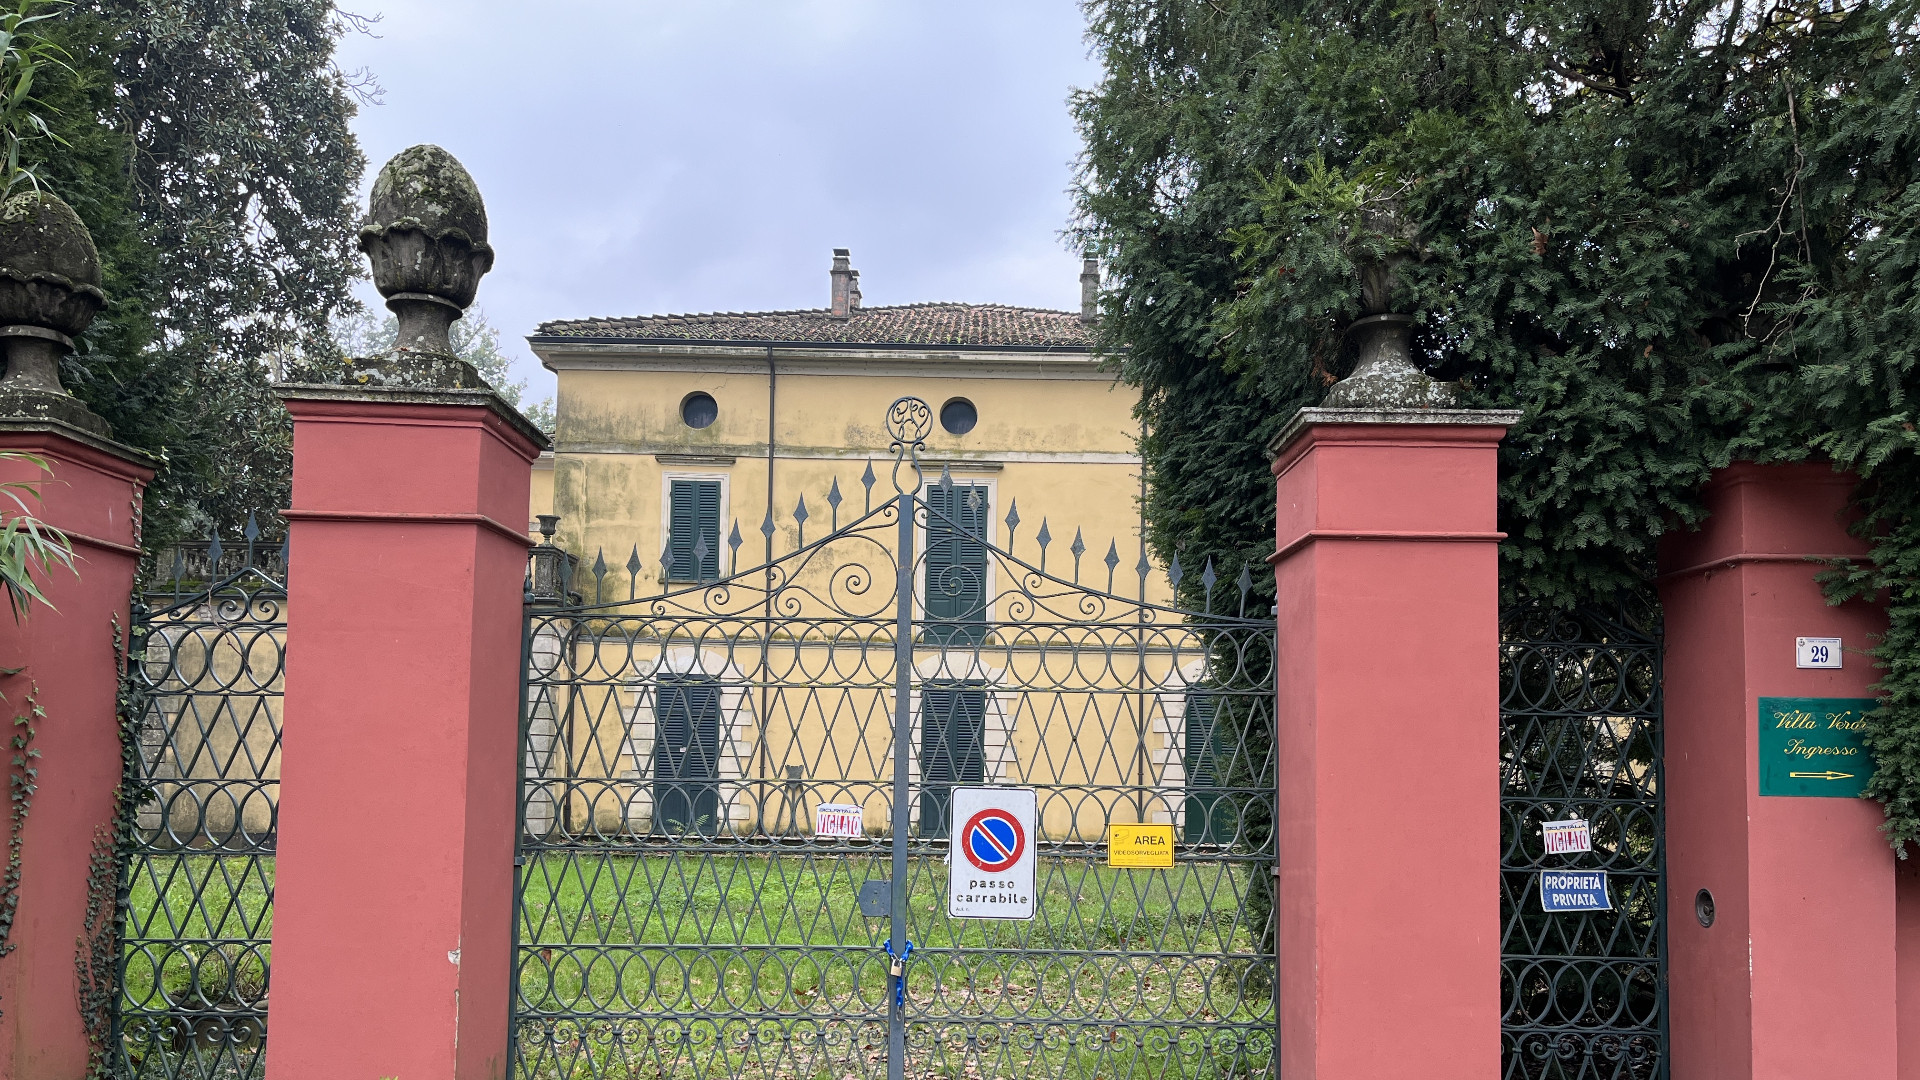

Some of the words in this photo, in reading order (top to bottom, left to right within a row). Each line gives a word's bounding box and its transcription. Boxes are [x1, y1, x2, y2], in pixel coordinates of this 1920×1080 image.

[1811, 645, 1829, 663] 29
[1773, 709, 1817, 730] Villa
[1783, 738, 1859, 760] Ingresso
[1134, 835, 1166, 846] AREA
[969, 879, 1015, 890] passo
[1545, 873, 1602, 890] PROPRIETÀ
[956, 892, 1028, 904] carrabile
[1552, 893, 1600, 907] PRIVATA
